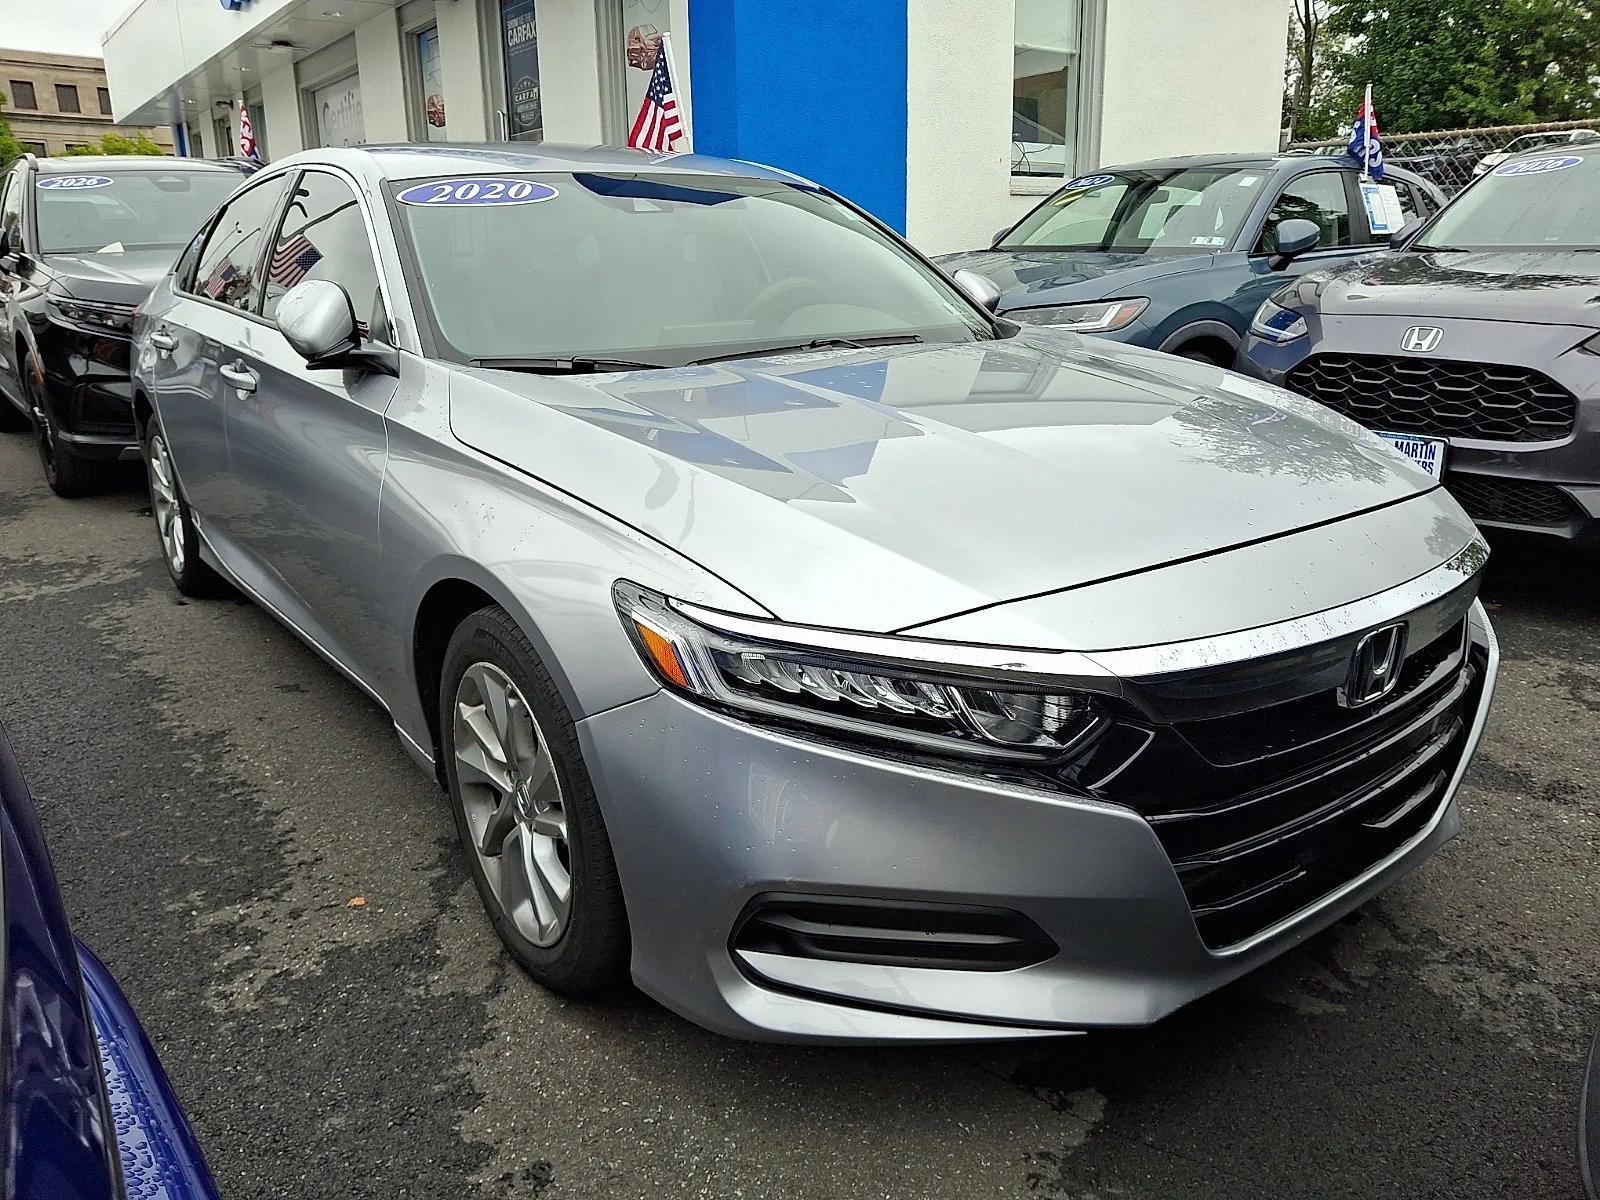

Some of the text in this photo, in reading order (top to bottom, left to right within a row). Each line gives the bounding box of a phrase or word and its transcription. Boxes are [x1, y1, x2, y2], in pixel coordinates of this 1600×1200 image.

[508, 21, 537, 47] CARFAX
[426, 182, 533, 203] 2020
[1394, 440, 1437, 461] MARTIN
